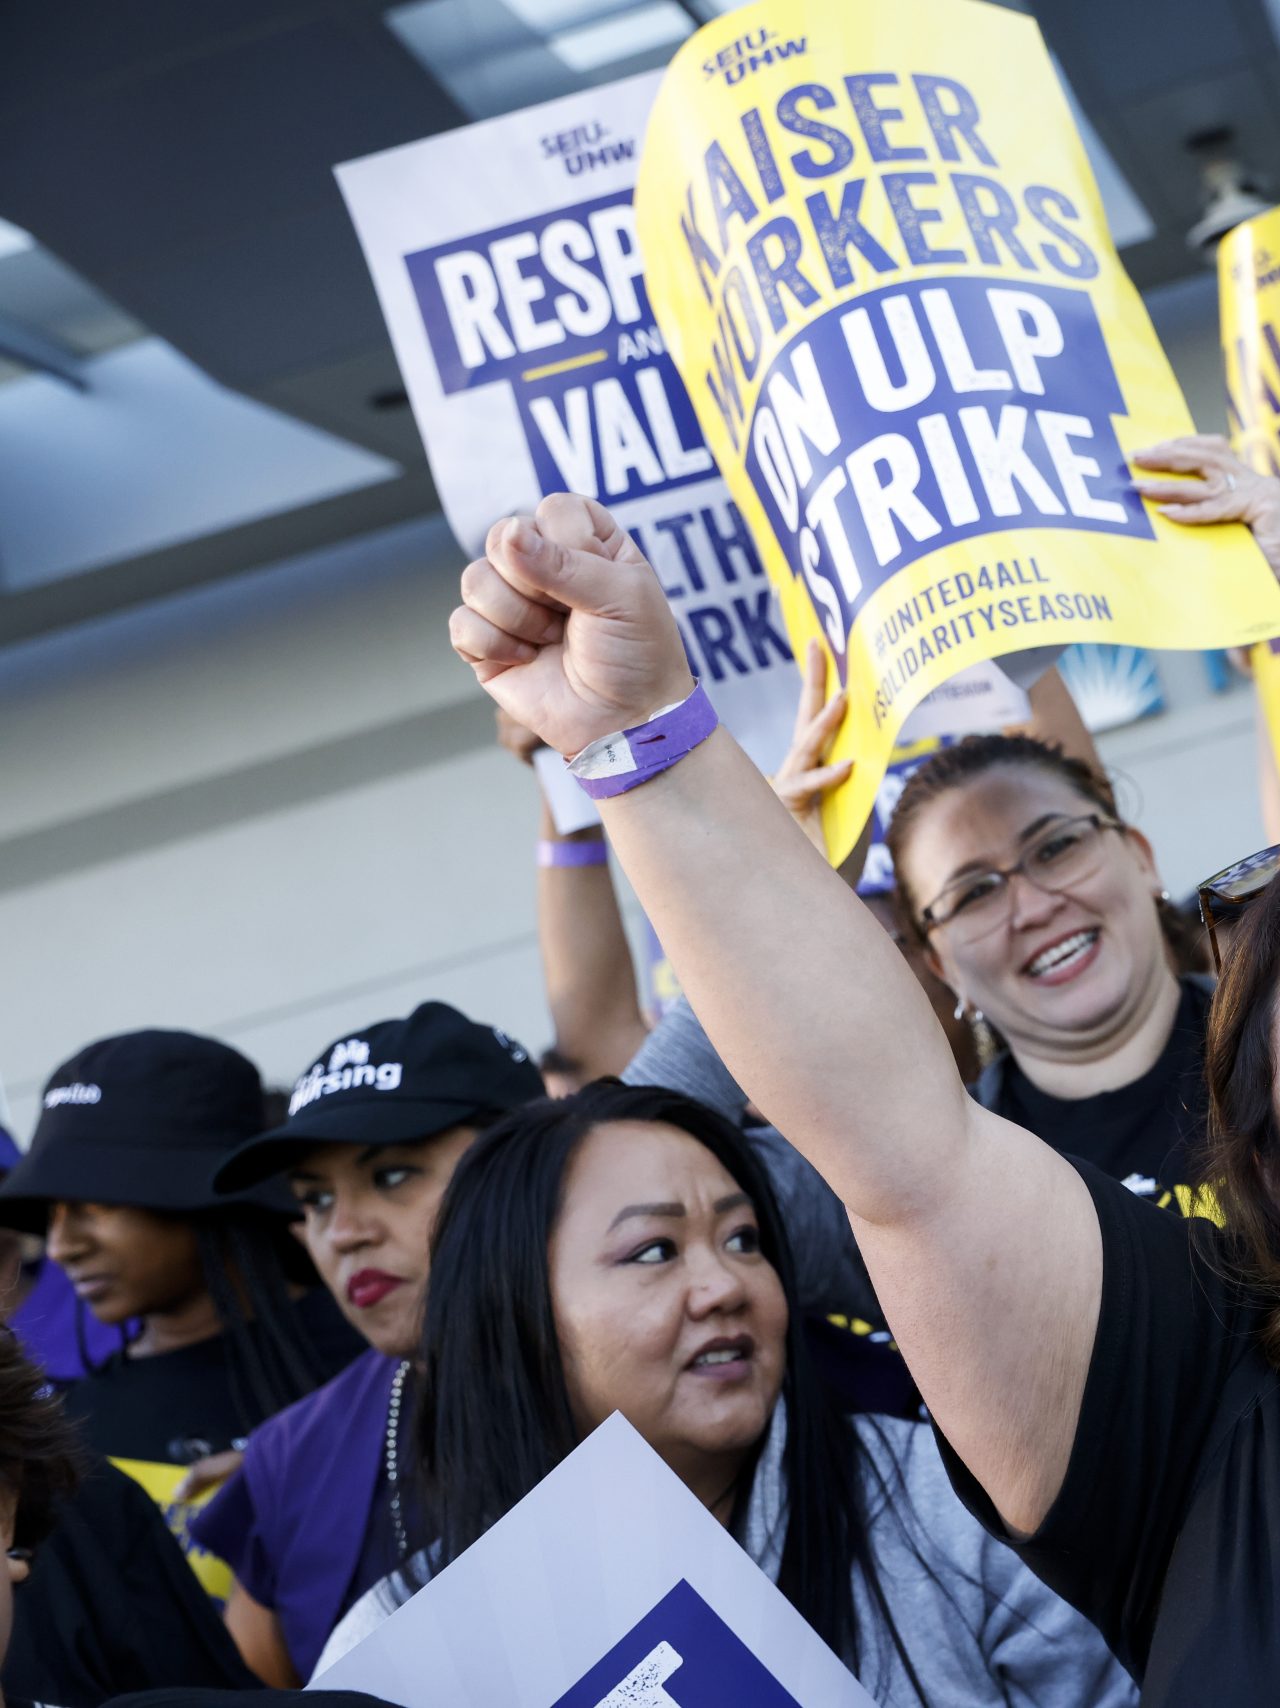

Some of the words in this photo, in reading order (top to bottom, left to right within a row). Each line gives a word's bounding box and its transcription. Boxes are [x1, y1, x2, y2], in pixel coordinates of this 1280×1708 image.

[723, 37, 808, 87] UHW
[433, 203, 646, 369] RESP
[680, 72, 1000, 305] KAISER
[617, 324, 664, 366] AN
[706, 170, 1100, 455] WORKERS
[753, 341, 841, 534] ON
[839, 287, 1065, 413] ULP
[529, 366, 713, 500] VAL
[799, 405, 1129, 655] STRIKE
